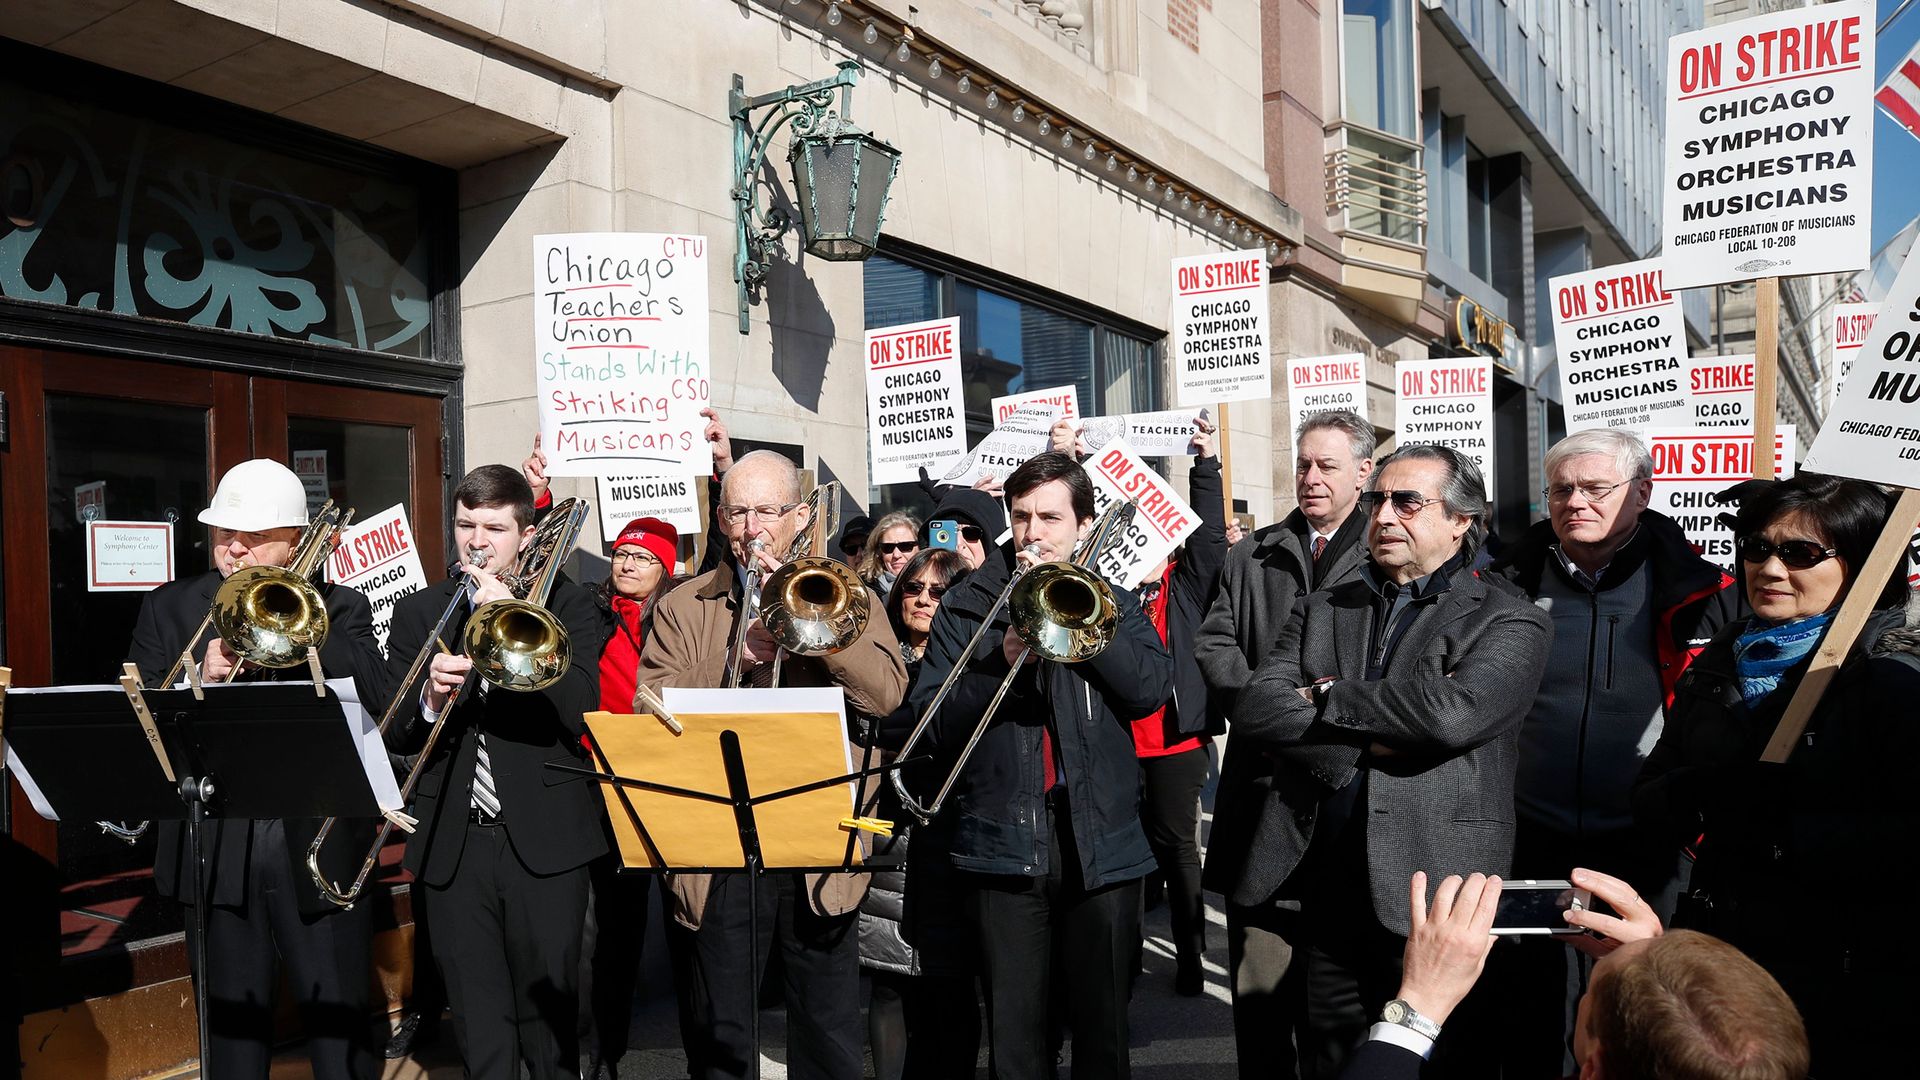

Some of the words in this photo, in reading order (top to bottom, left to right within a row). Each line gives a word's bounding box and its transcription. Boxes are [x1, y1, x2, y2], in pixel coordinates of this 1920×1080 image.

[1680, 42, 1722, 94] ON
[1736, 16, 1860, 82] STRIKE
[1699, 85, 1835, 125] CHICAGO
[1683, 116, 1851, 160] SYMPHONY
[1676, 149, 1856, 191] ORCHESTRA
[1682, 183, 1848, 222] MUSICIANS
[1674, 230, 1716, 246] CHICAGO
[1719, 222, 1778, 240] FEDERATION
[1781, 220, 1795, 232] OF
[1798, 214, 1856, 230] MUSICIANS
[663, 236, 703, 258] CTU
[1728, 240, 1758, 254] LOCAL
[1761, 235, 1796, 249] 10-208
[547, 246, 674, 297] Chicago
[1178, 266, 1200, 291] ON
[1204, 259, 1260, 288] STRIKE
[545, 292, 684, 318] Teachers
[1191, 299, 1251, 318] CHICAGO
[1558, 284, 1588, 319] ON
[553, 320, 632, 343] Union
[1185, 316, 1258, 337] SYMPHONY
[1576, 315, 1661, 341] CHICAGO
[1836, 315, 1849, 343] ON
[1850, 314, 1878, 342] STRI
[870, 339, 891, 365] ON
[895, 330, 953, 362] STRIKE
[1183, 334, 1262, 355] ORCHESTRA
[1569, 335, 1673, 363] SYMPHONY
[543, 352, 626, 381] Stands
[638, 349, 700, 377] With
[1187, 351, 1260, 372] MUSICIANS
[1568, 356, 1680, 385] ORCHESTRA
[885, 369, 941, 389] CHICAGO
[1184, 380, 1204, 388] CHICAGO
[1205, 378, 1232, 386] FEDERATION
[1240, 374, 1265, 382] MUSICIANS
[1294, 364, 1310, 385] ON
[1314, 362, 1360, 382] STRIKE
[1402, 371, 1423, 397] ON
[1430, 367, 1486, 395] STRIKE
[1690, 364, 1754, 390] STRIKE
[672, 378, 709, 400] CSO
[879, 387, 950, 409] SYMPHONY
[1304, 392, 1353, 406] CHICAGO
[1575, 379, 1678, 406] MUSICIANS
[552, 389, 669, 422] Striking
[878, 406, 955, 427] ORCHESTRA
[1412, 403, 1475, 415] CHICAGO
[1573, 411, 1600, 422] CHICAGO
[1601, 406, 1638, 418] FEDERATION
[1639, 404, 1648, 413] OF
[1649, 399, 1685, 411] MUSICIANS
[1695, 402, 1741, 417] ICAGO
[1132, 425, 1195, 435] TEACHERS
[1405, 420, 1483, 433] SYMPHONY
[1607, 417, 1627, 427] LOCAL
[1629, 414, 1651, 424] 10-208
[1839, 420, 1893, 438] CHICAGO
[557, 431, 693, 453] Musicans
[882, 425, 954, 446] MUSICIANS
[1131, 437, 1173, 446] UNION
[900, 453, 928, 461] FEDERATION
[936, 449, 960, 457] MUSICIANS
[981, 454, 1025, 467] TEACH
[1651, 443, 1683, 475] ON
[611, 482, 687, 501] MUSICIANS
[1100, 449, 1134, 480] ON
[1124, 472, 1189, 539] STRIKE
[610, 511, 631, 519] CHICAGO
[631, 509, 660, 518] FEDERATION
[668, 506, 693, 514] MUSICIANS
[104, 542, 137, 551] Symphony
[334, 543, 356, 579] ON
[354, 518, 408, 569] STRIKE
